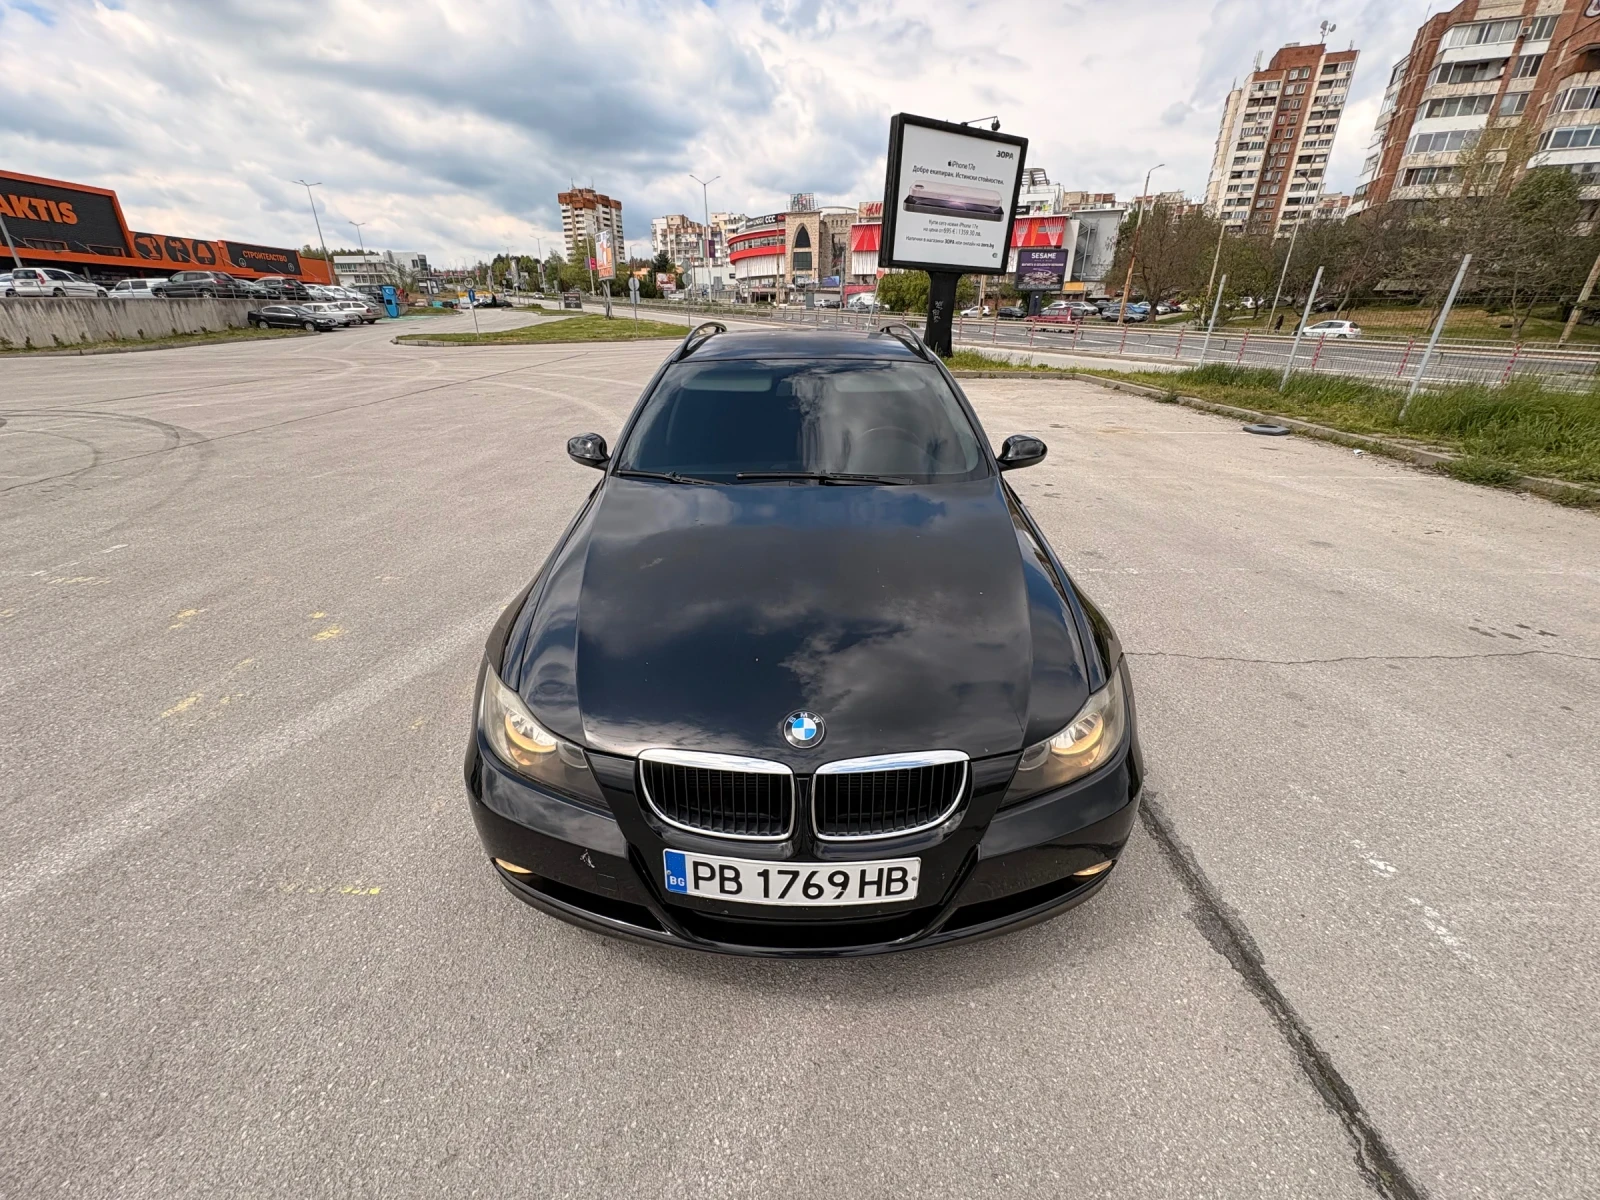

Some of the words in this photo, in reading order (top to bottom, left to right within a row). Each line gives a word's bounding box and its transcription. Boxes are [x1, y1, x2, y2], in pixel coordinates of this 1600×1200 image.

[996, 150, 1014, 160] ЗОРА
[952, 160, 968, 169] iPhone
[912, 165, 929, 174] Добре
[955, 172, 978, 180] Истински
[765, 215, 776, 223] CCC
[242, 250, 287, 262] СТРОИТЕЛСТВО
[788, 712, 820, 724] BMW
[669, 875, 685, 887] BG
[692, 860, 743, 896] PB
[756, 868, 850, 900] 1769
[858, 866, 909, 899] HB
